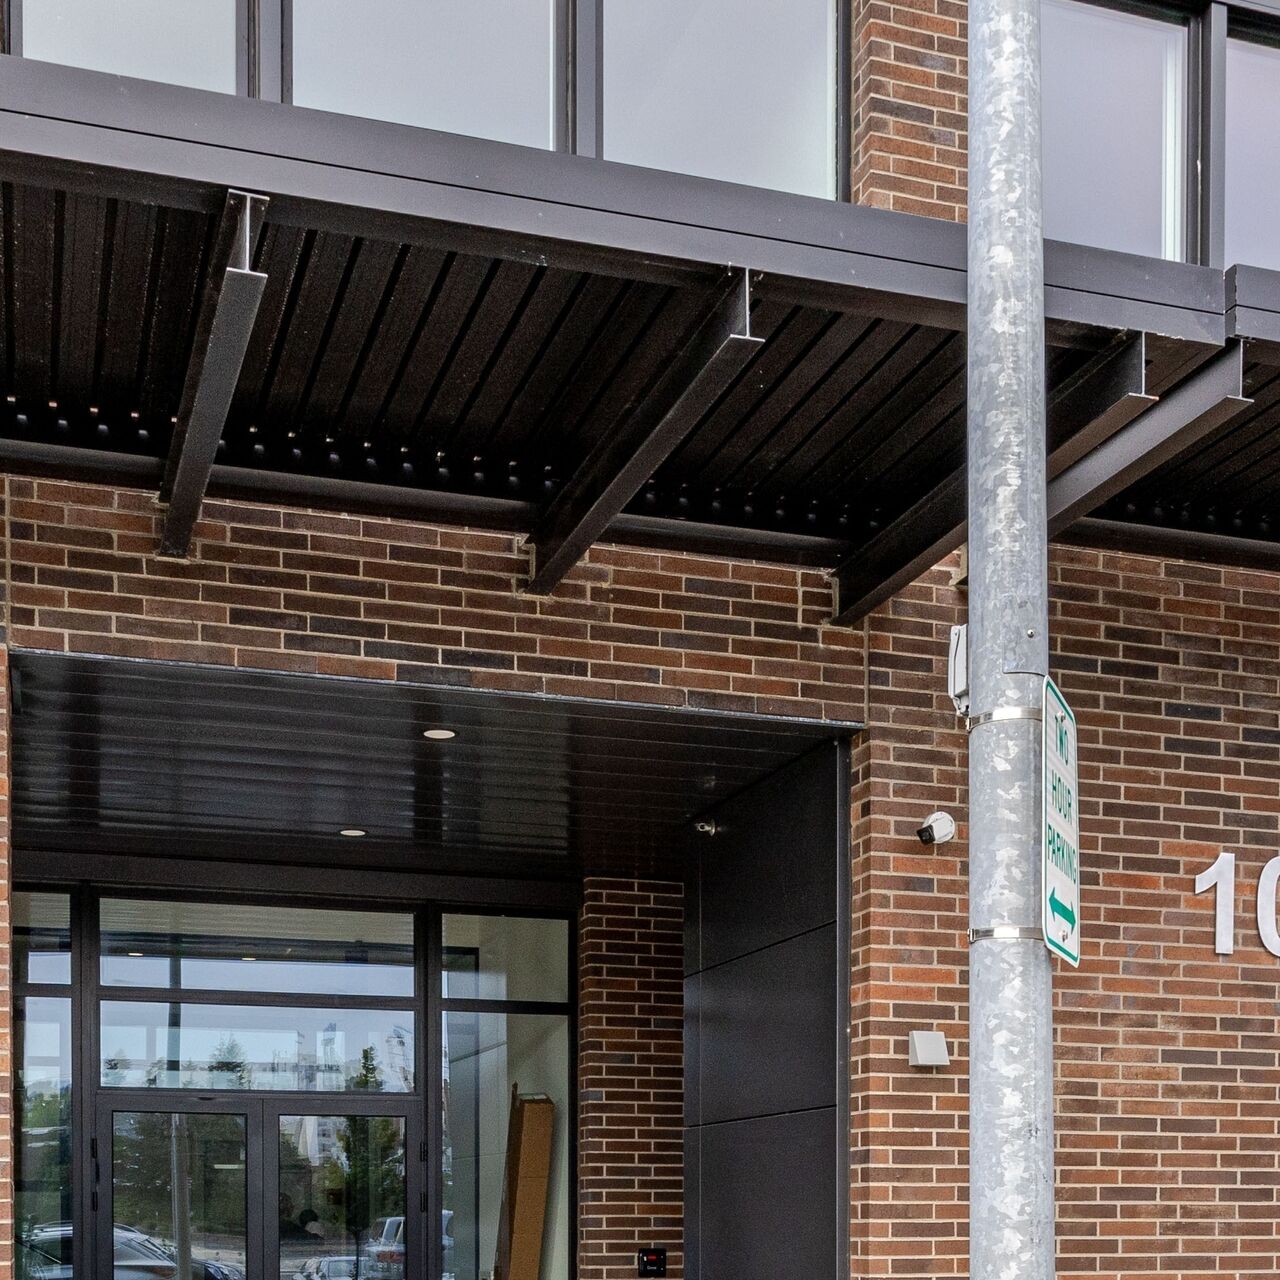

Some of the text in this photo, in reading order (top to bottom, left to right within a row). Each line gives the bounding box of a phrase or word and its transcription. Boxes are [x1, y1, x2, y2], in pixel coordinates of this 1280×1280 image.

[1054, 714, 1069, 766] TWO
[1051, 769, 1073, 825] HOUR
[1047, 823, 1077, 884] PARKING
